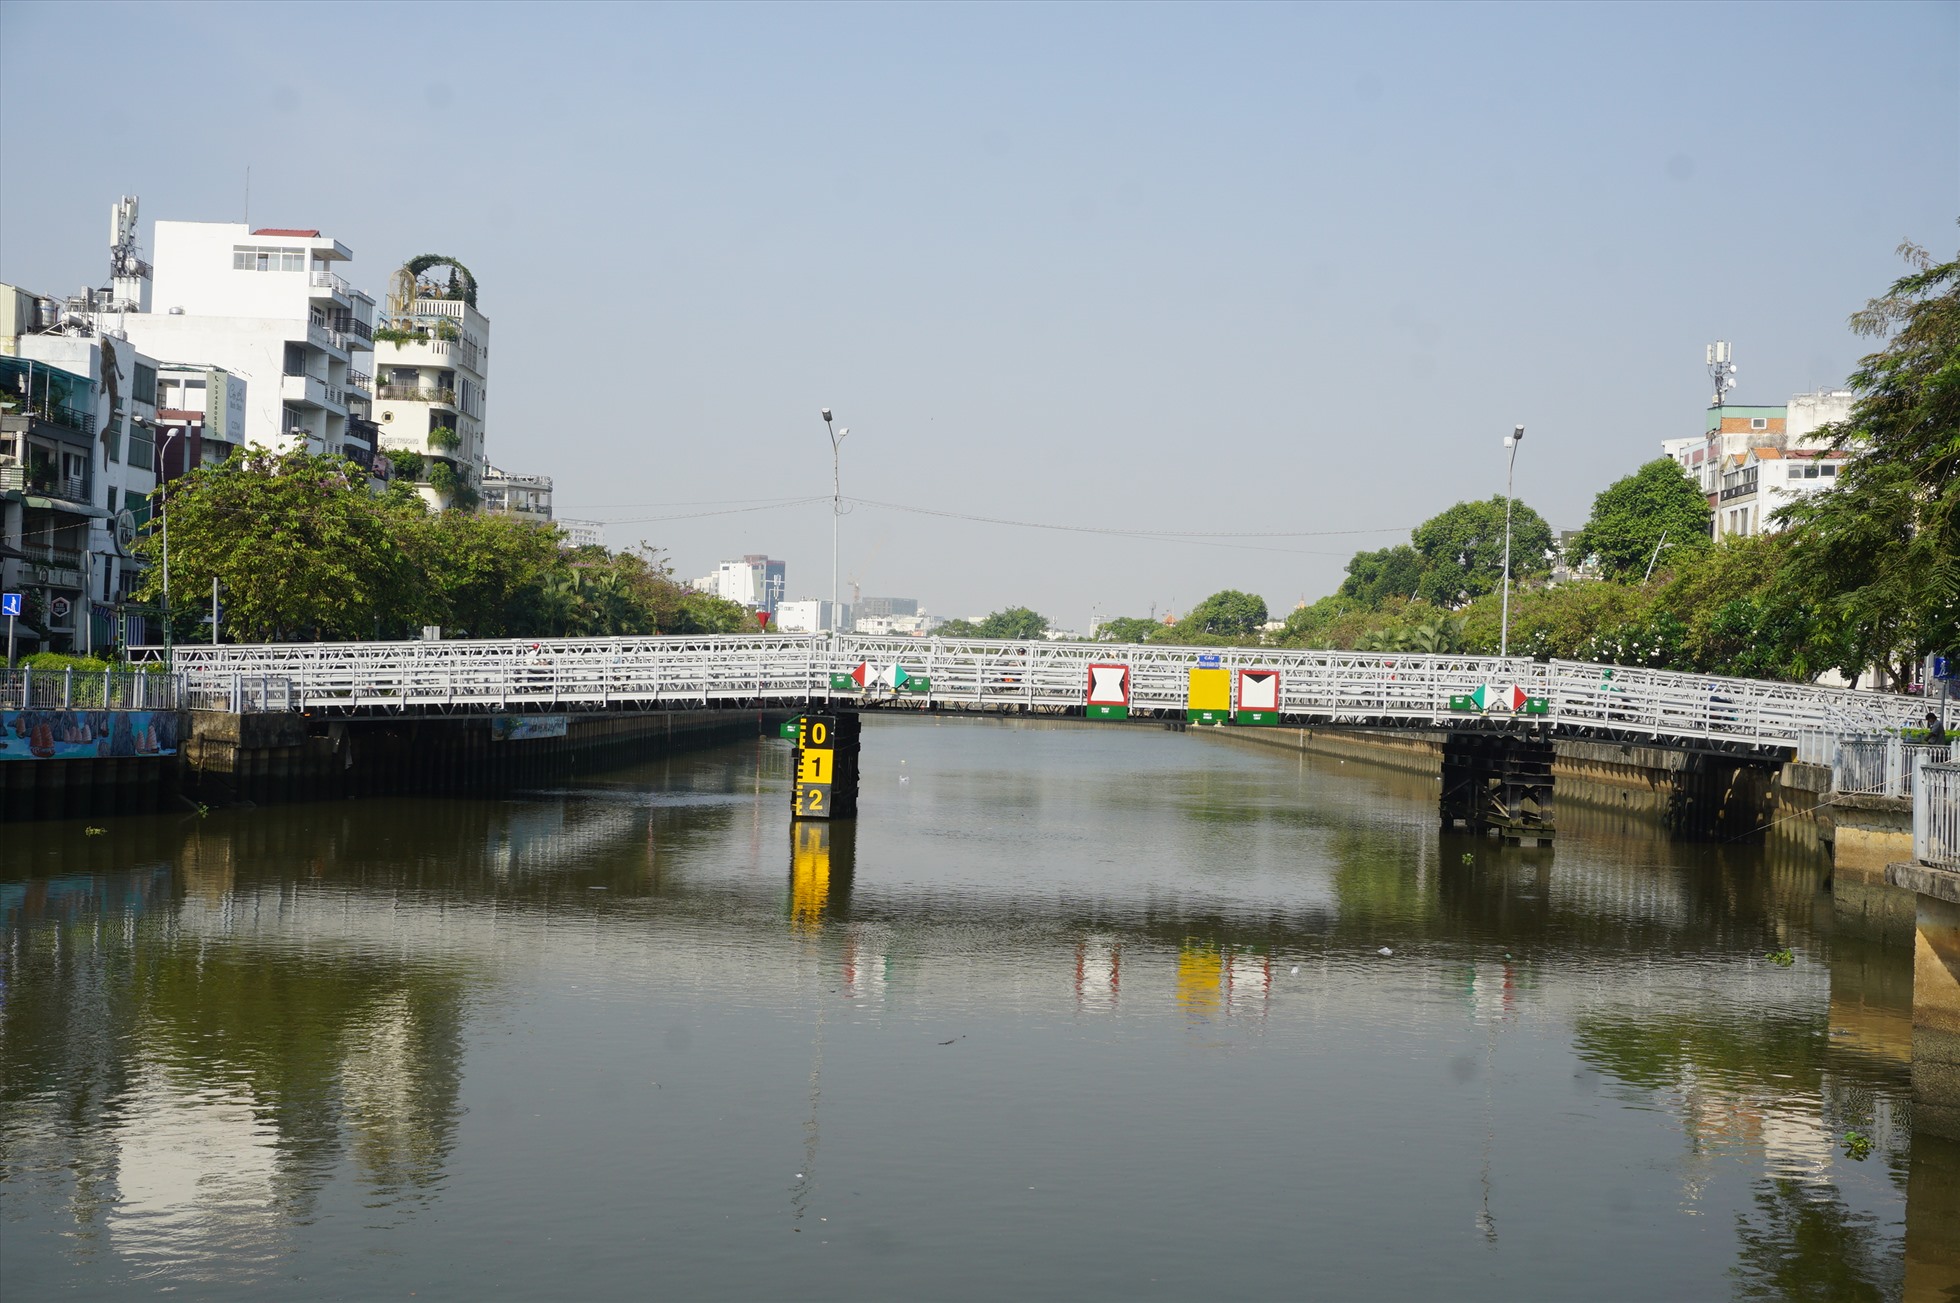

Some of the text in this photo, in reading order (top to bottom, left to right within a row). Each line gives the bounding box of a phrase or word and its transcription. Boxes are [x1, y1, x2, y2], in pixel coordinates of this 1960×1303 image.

[811, 723, 826, 744] 0
[811, 757, 821, 777] 1
[808, 789, 823, 811] 2
